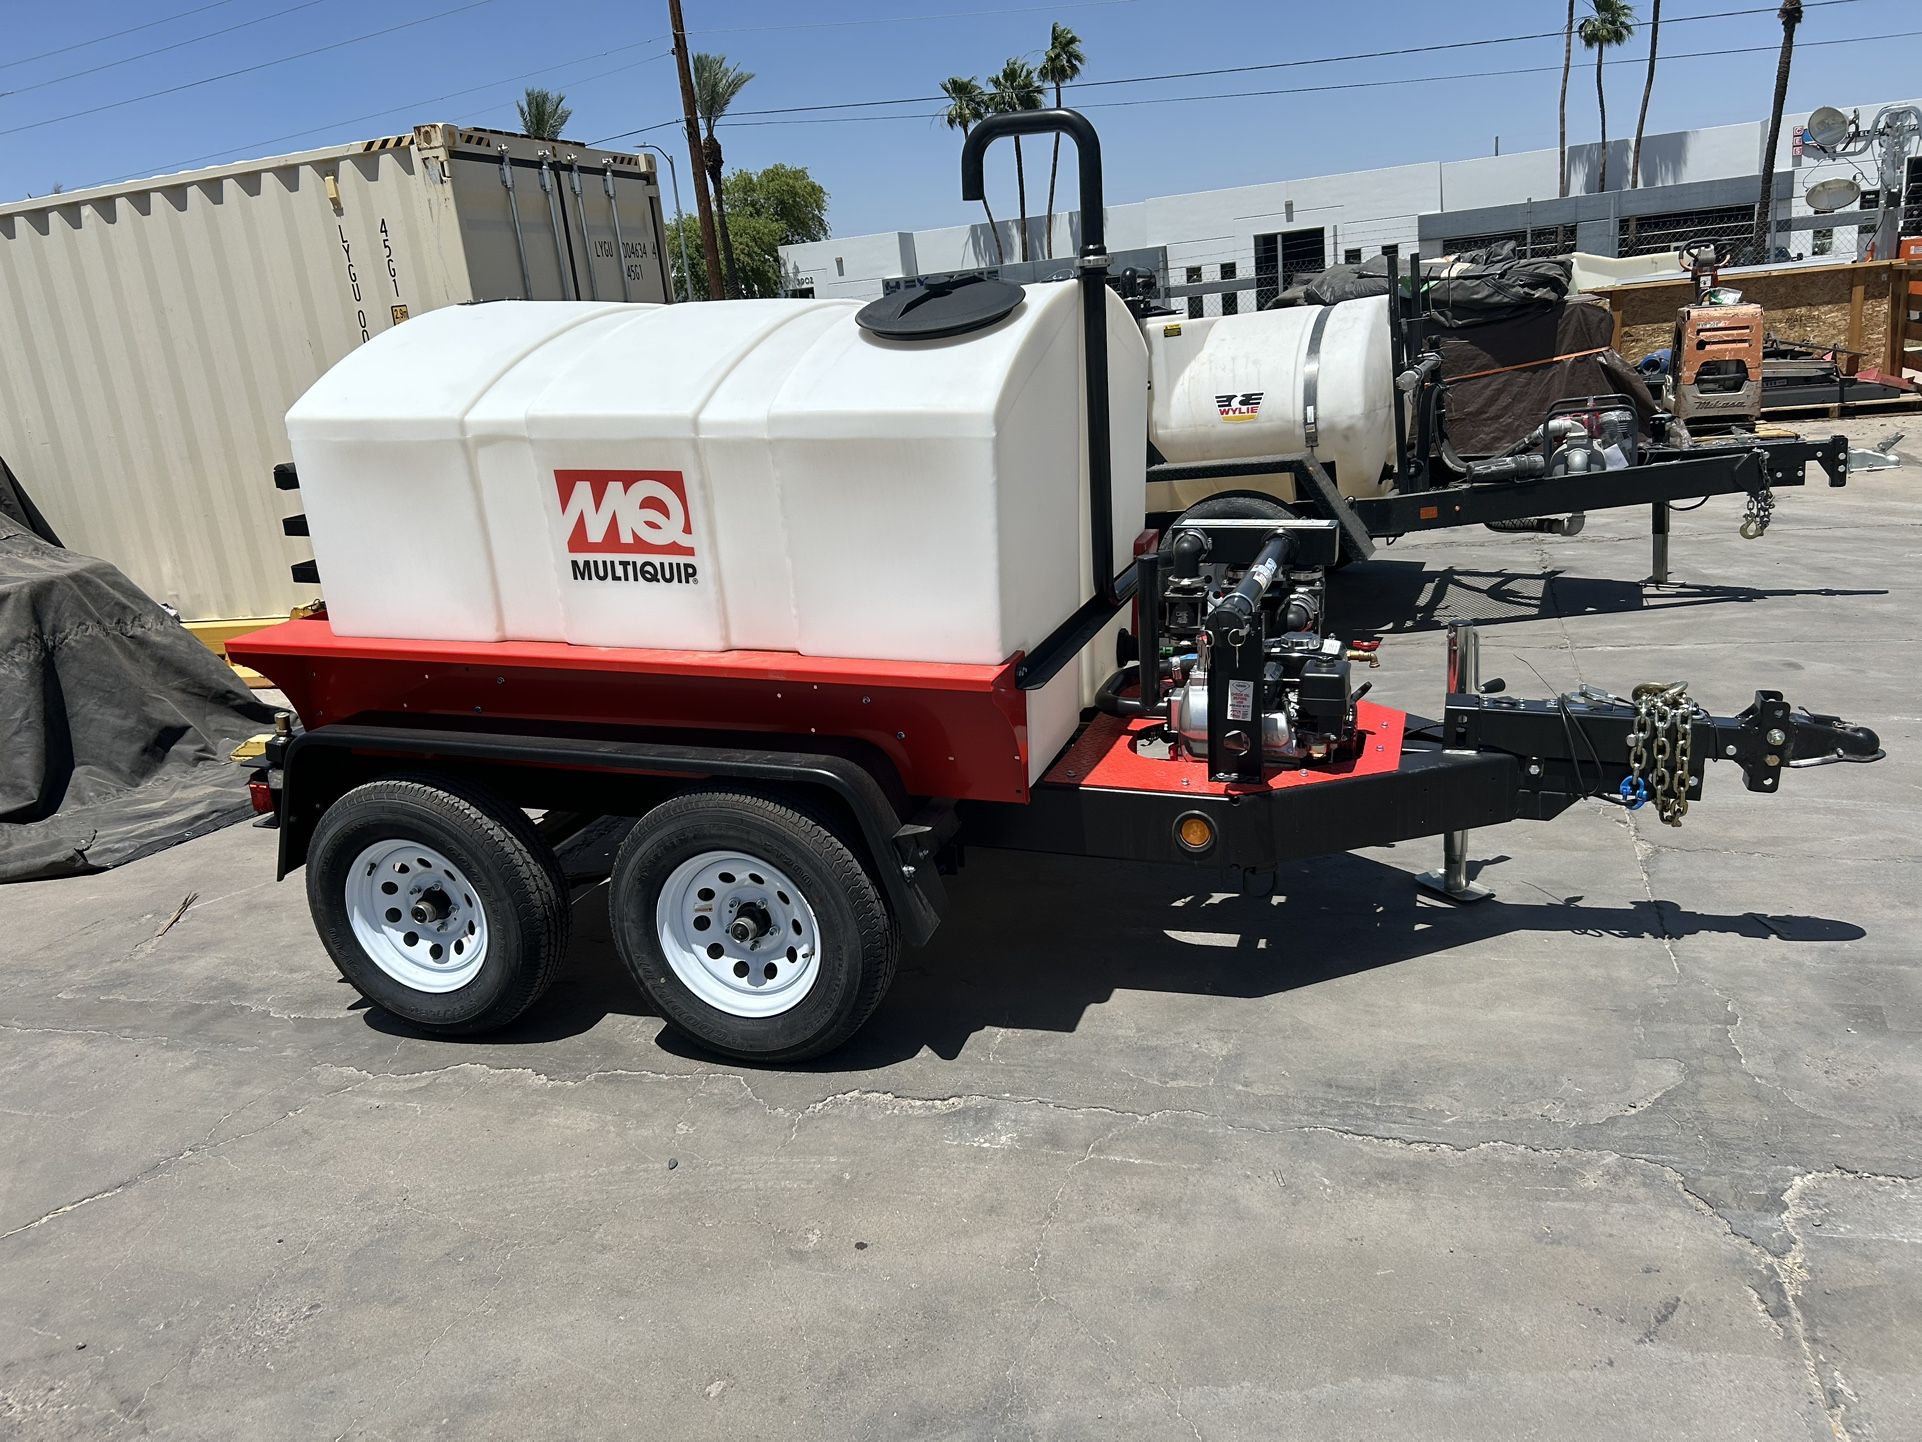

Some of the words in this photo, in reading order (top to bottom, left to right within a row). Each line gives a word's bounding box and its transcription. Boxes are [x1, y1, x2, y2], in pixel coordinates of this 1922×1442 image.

[379, 218, 400, 298] 45G1
[594, 241, 614, 258] LYGU
[338, 224, 362, 302] LYGU
[627, 264, 644, 281] 45G1
[1219, 406, 1260, 416] WYLIE
[1694, 400, 1747, 410] Mikasa
[561, 479, 694, 549] MQ
[570, 559, 698, 585] MULTIQUIP
